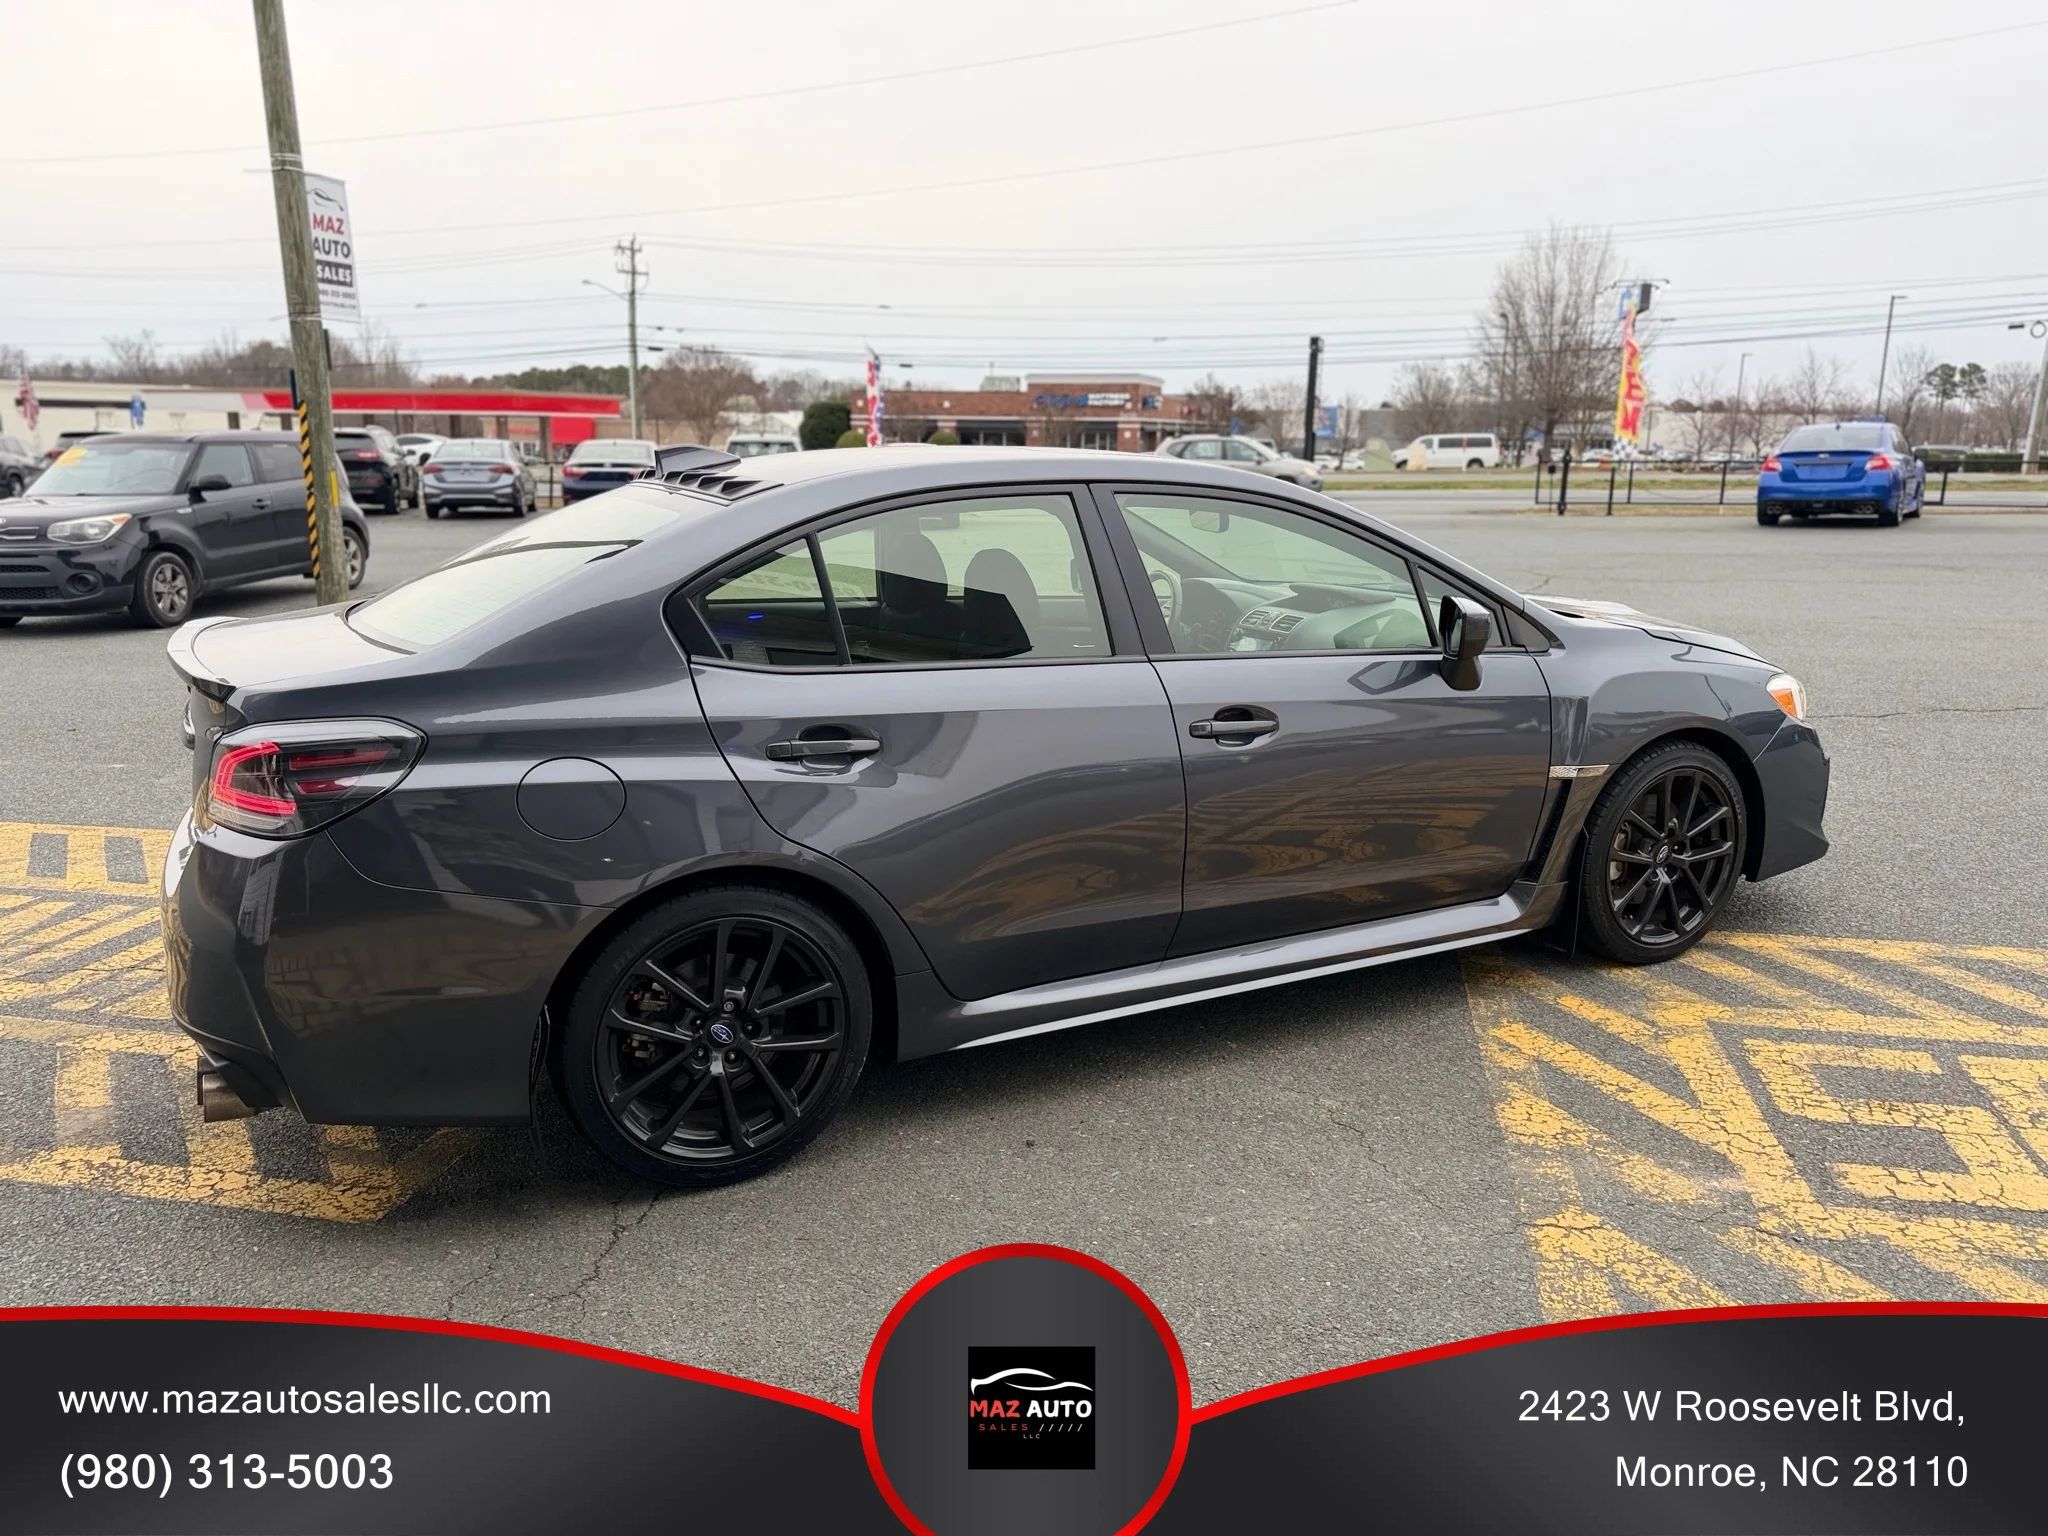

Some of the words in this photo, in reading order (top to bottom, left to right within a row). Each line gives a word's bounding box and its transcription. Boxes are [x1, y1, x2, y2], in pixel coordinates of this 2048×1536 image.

[312, 213, 344, 235] MAZ
[312, 236, 351, 258] AUTO
[316, 264, 352, 283] SALES
